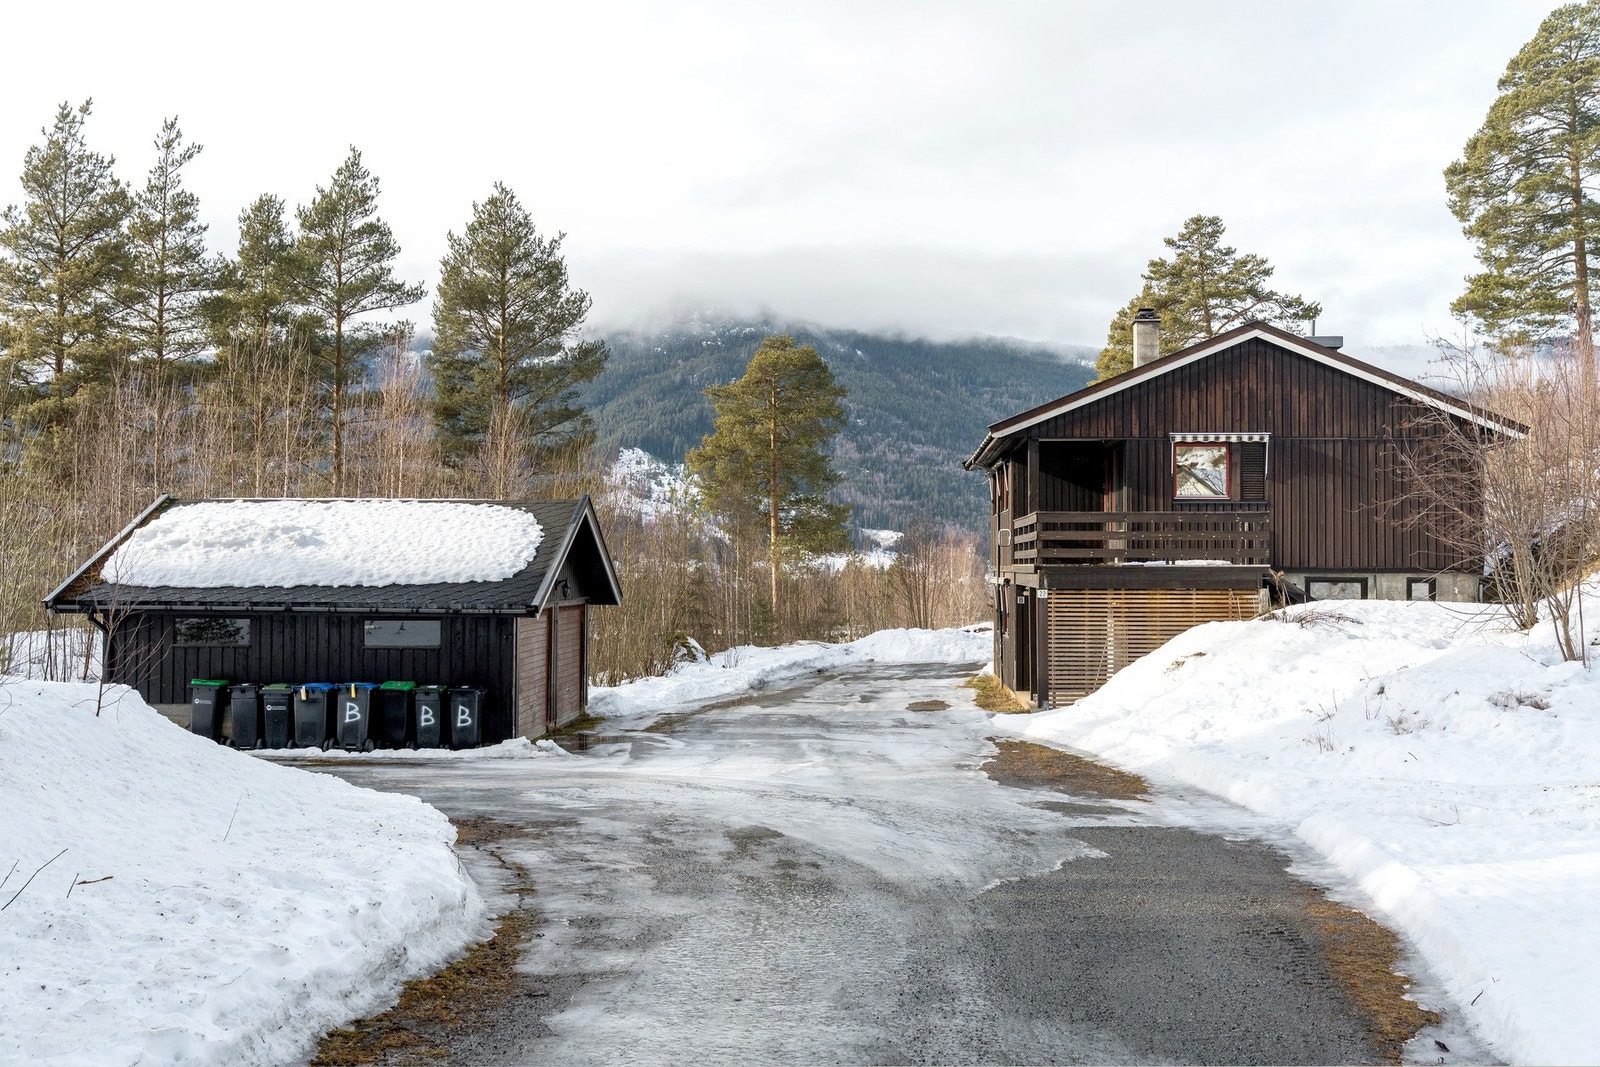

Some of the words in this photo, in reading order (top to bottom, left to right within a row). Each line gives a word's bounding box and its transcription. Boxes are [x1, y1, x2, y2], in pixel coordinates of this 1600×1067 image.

[344, 702, 361, 722] B
[421, 705, 435, 726] B
[457, 705, 472, 726] B
